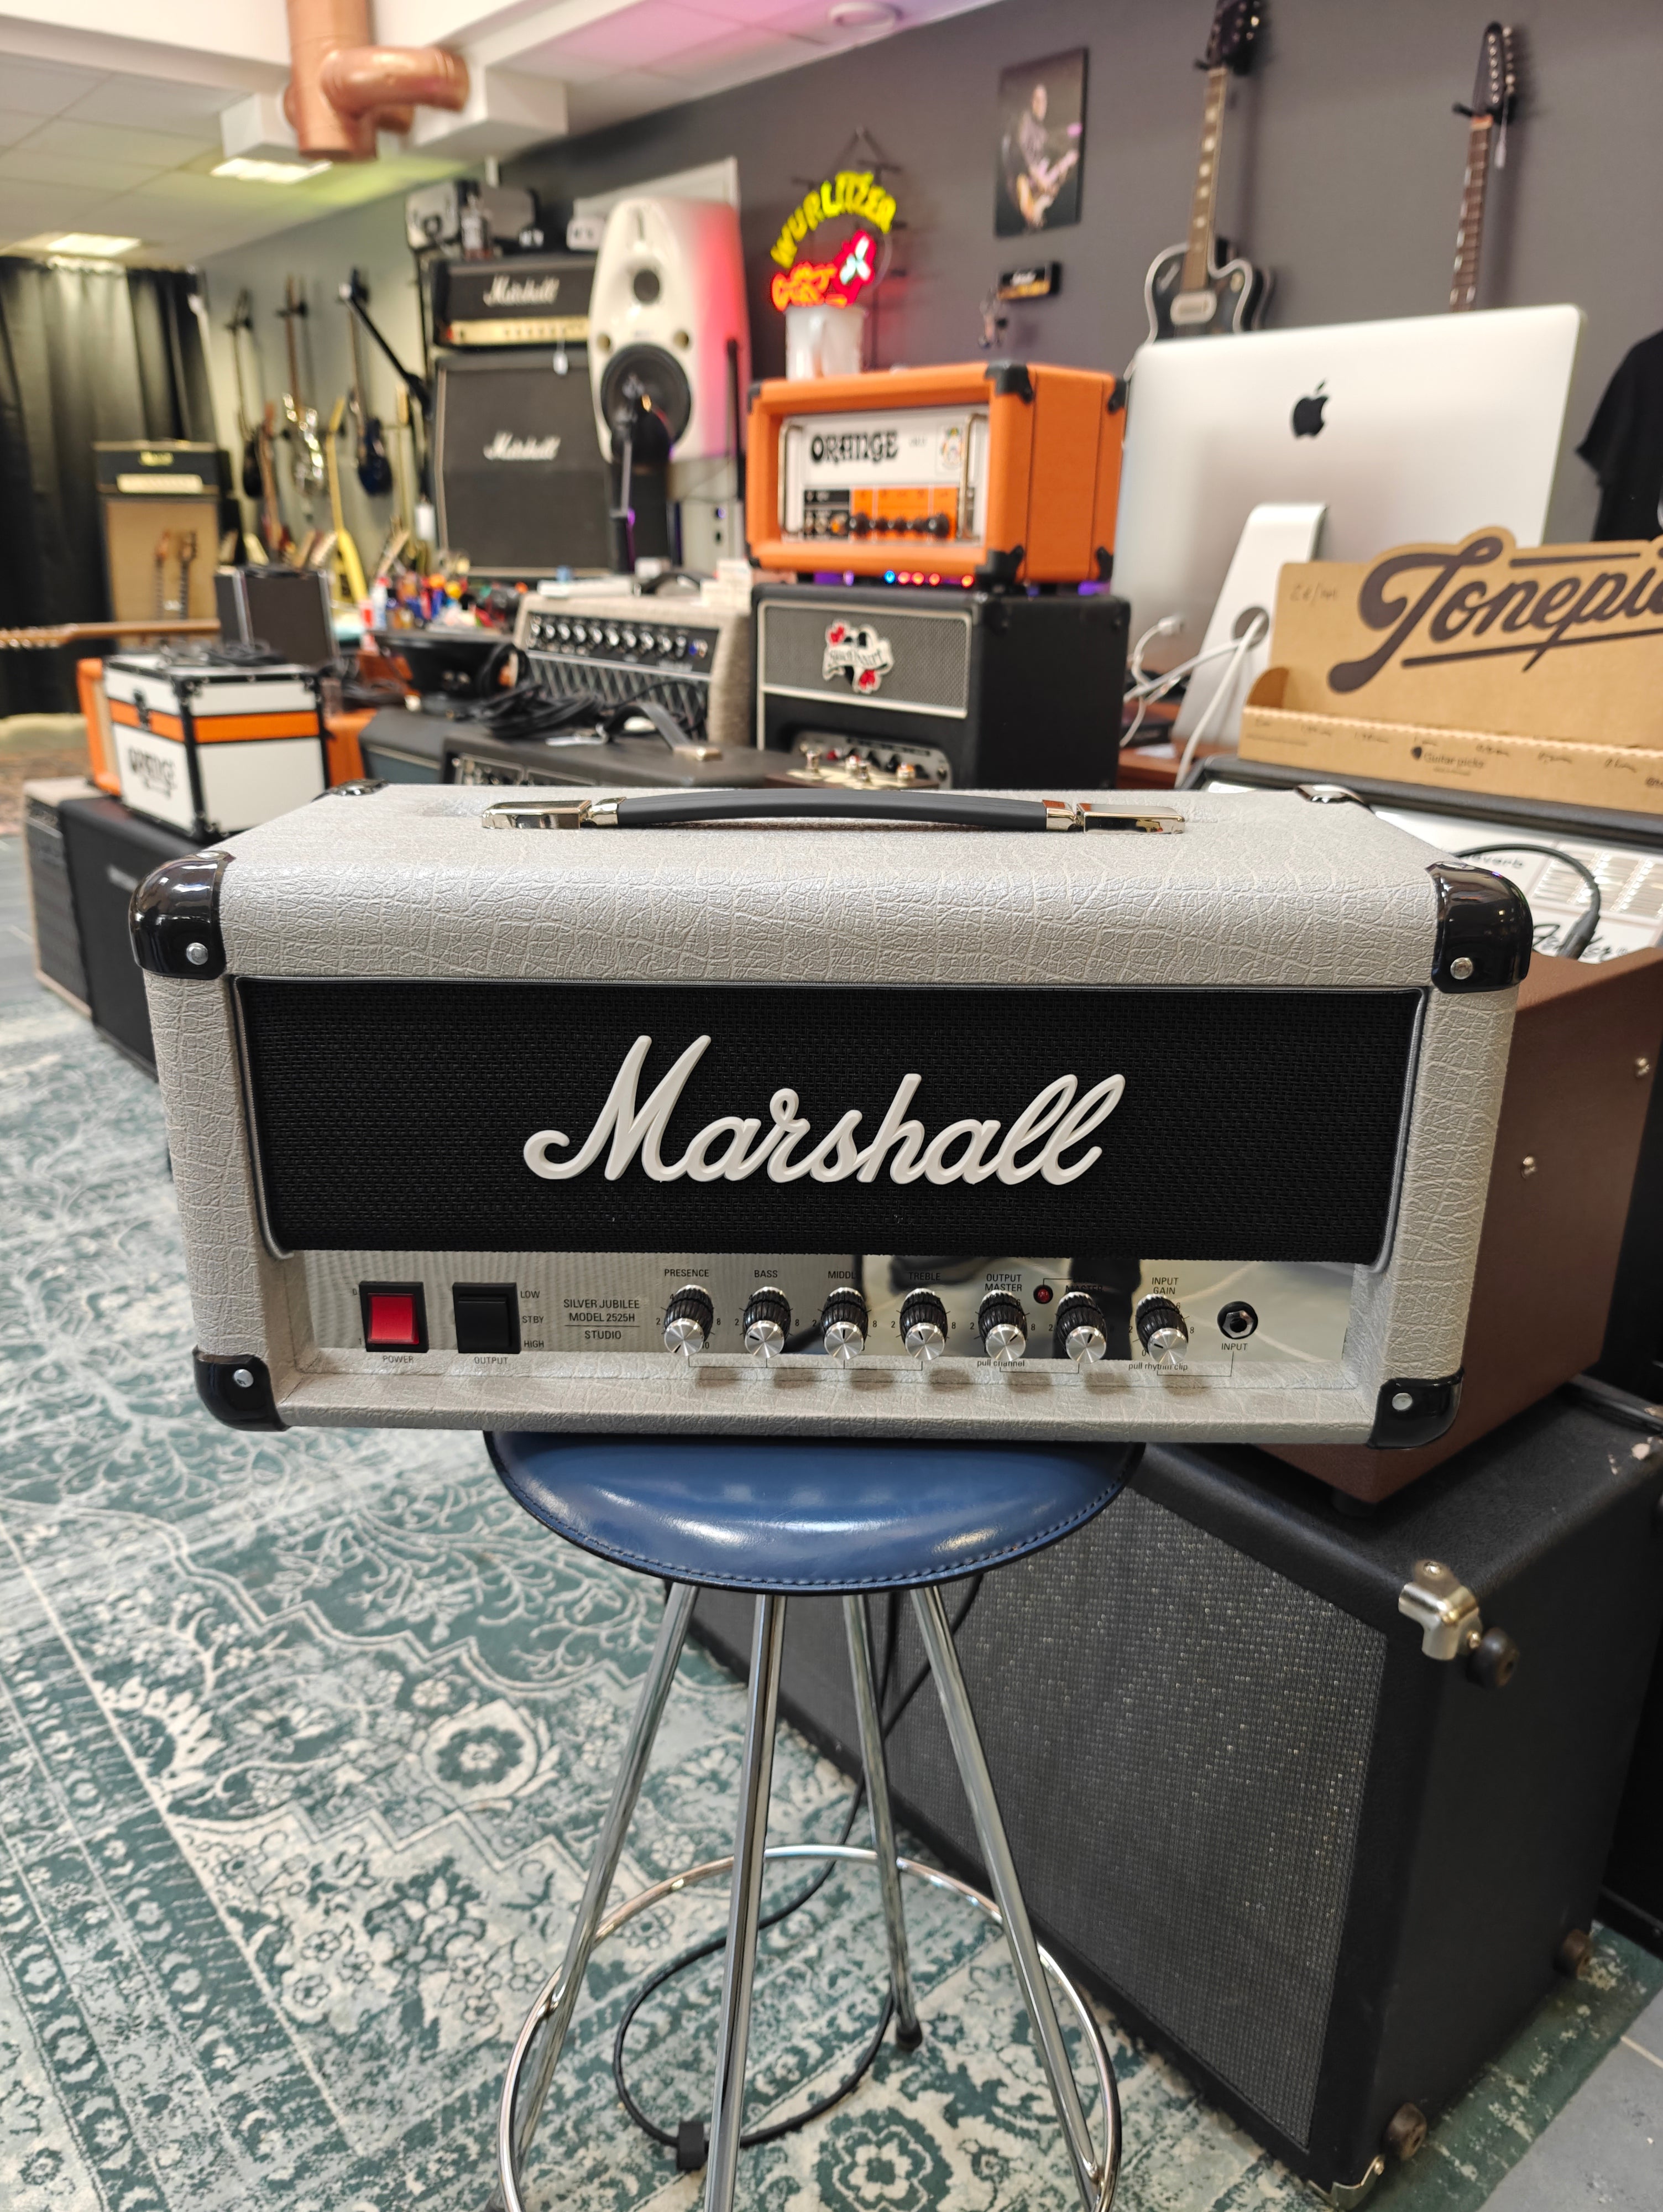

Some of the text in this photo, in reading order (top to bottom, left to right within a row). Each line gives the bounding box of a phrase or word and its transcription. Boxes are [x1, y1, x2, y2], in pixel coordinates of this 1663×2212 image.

[771, 173, 896, 269] WURLITZER
[810, 429, 898, 463] ORANGE
[523, 1035, 1126, 1185] Marshall
[664, 1269, 709, 1277] PRESENCE
[909, 1272, 941, 1281] TREBLE
[986, 1274, 1022, 1282] OUTPUT
[1152, 1277, 1179, 1285] INPUT
[985, 1283, 1022, 1292] MASTER
[1153, 1287, 1175, 1295] GAIN
[520, 1291, 540, 1299] LOW
[564, 1299, 640, 1309] SILVER JUBILEE
[569, 1313, 635, 1322] MODEL 2525H
[585, 1330, 621, 1339] STUDIO
[1221, 1343, 1248, 1351] INPUT
[474, 1357, 508, 1365] OUTPUT
[977, 1359, 991, 1368] pull
[1128, 1362, 1143, 1371] pull
